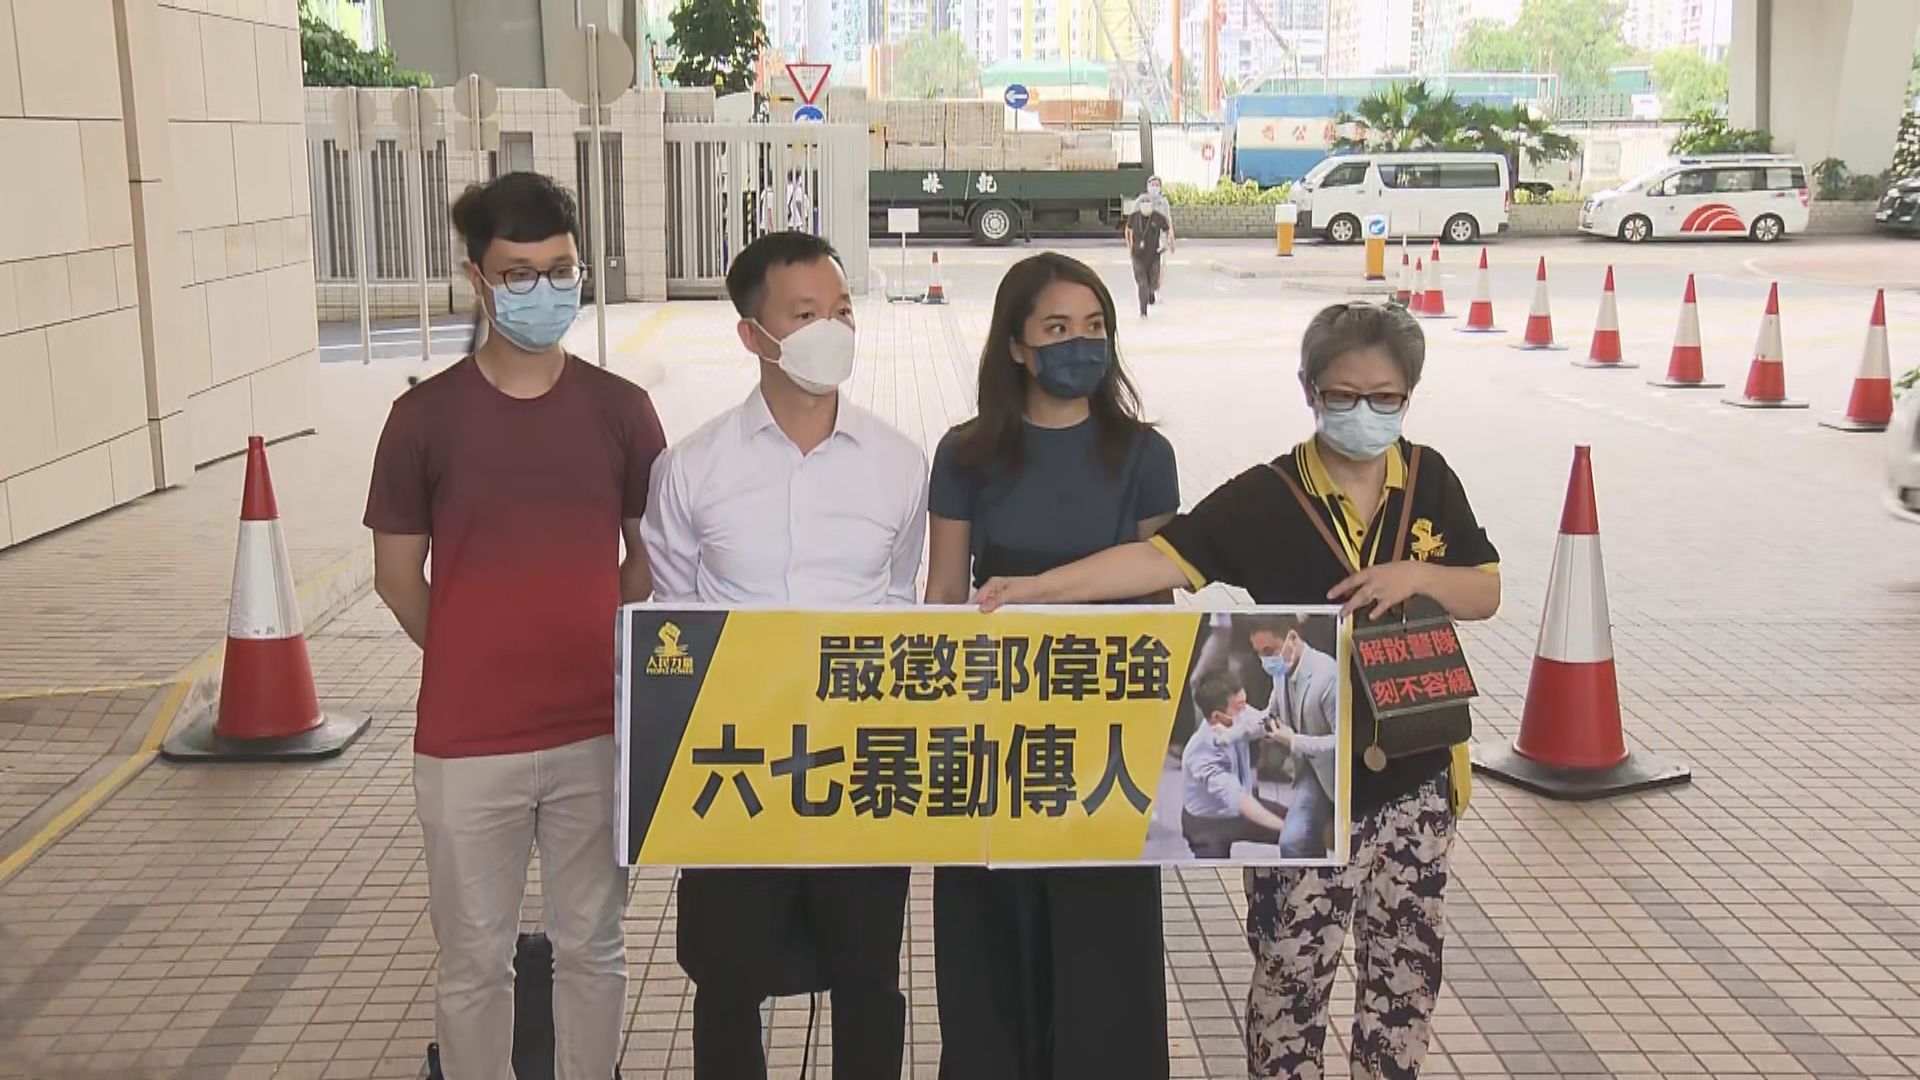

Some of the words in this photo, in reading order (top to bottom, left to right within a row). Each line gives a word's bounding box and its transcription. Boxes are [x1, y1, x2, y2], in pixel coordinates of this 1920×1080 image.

[816, 634, 1171, 701] 嚴懲郭偉強
[1359, 628, 1458, 667] 解散警隊
[1371, 666, 1474, 707] 刻不容緩
[692, 723, 1152, 819] 六七暴動傳人
